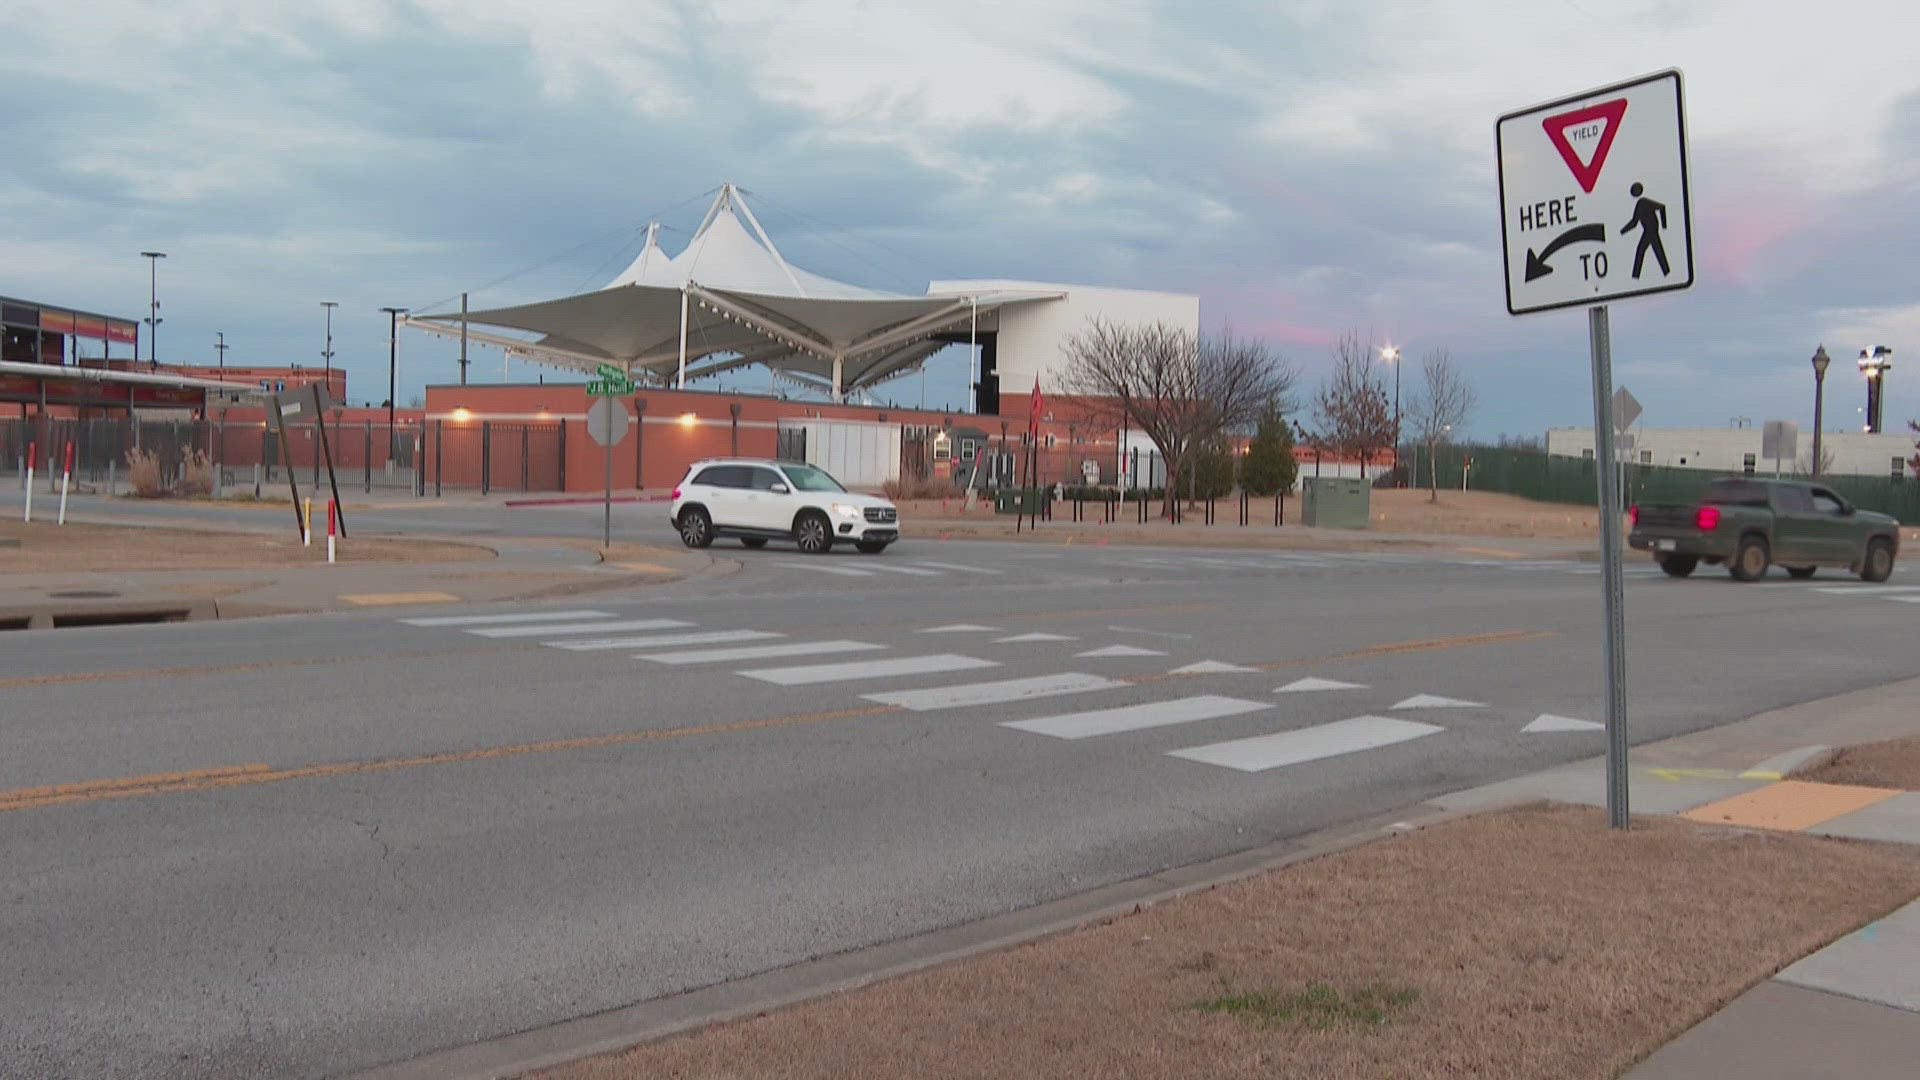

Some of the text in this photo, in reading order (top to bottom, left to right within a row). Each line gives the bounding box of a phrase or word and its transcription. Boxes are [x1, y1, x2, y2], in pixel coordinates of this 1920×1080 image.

[1572, 125, 1599, 141] YIELD
[1519, 195, 1578, 231] HERE
[1579, 251, 1608, 281] TO
